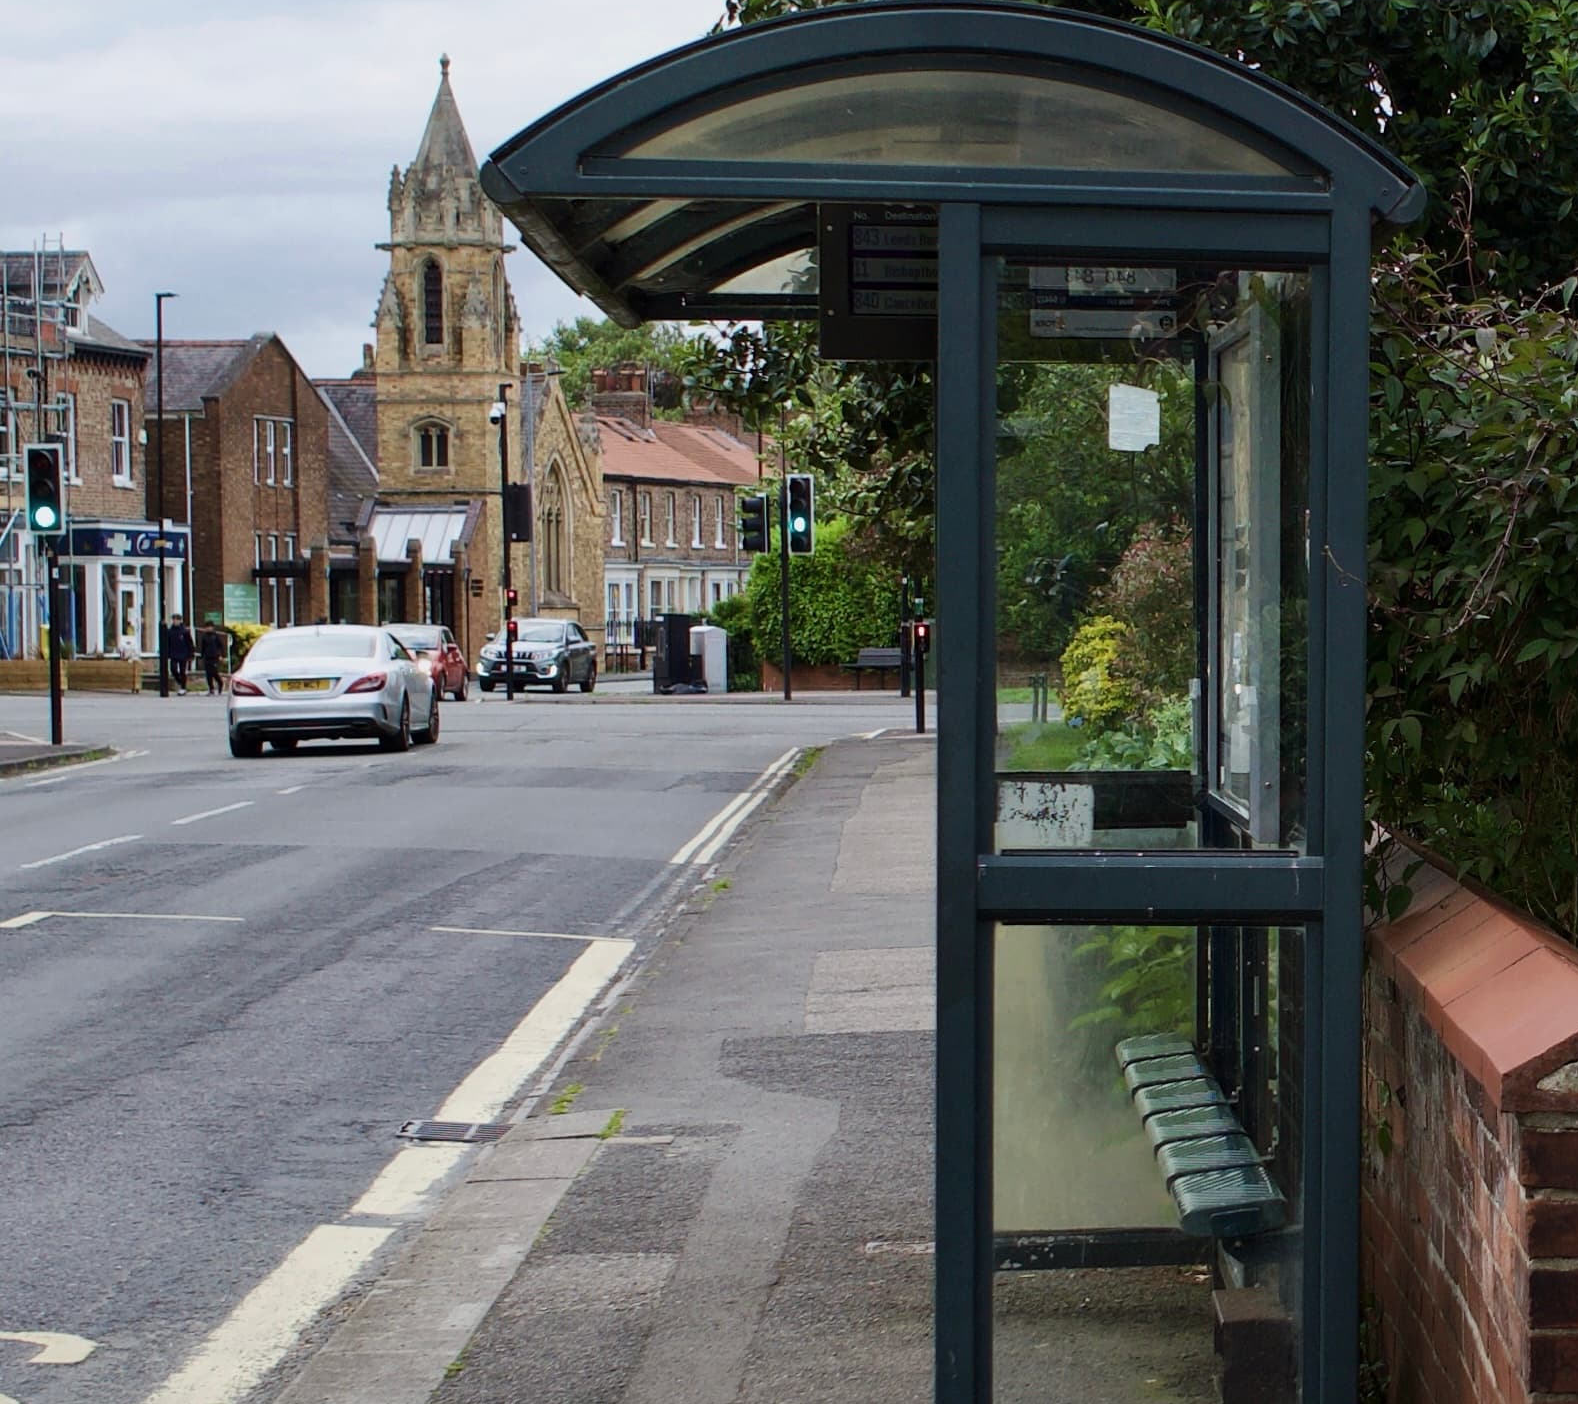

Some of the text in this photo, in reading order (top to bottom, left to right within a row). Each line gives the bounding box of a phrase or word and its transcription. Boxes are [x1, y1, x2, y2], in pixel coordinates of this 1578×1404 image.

[853, 211, 937, 221] No. Destination
[854, 228, 880, 246] 843
[854, 260, 869, 277] 11
[854, 292, 879, 310] 840
